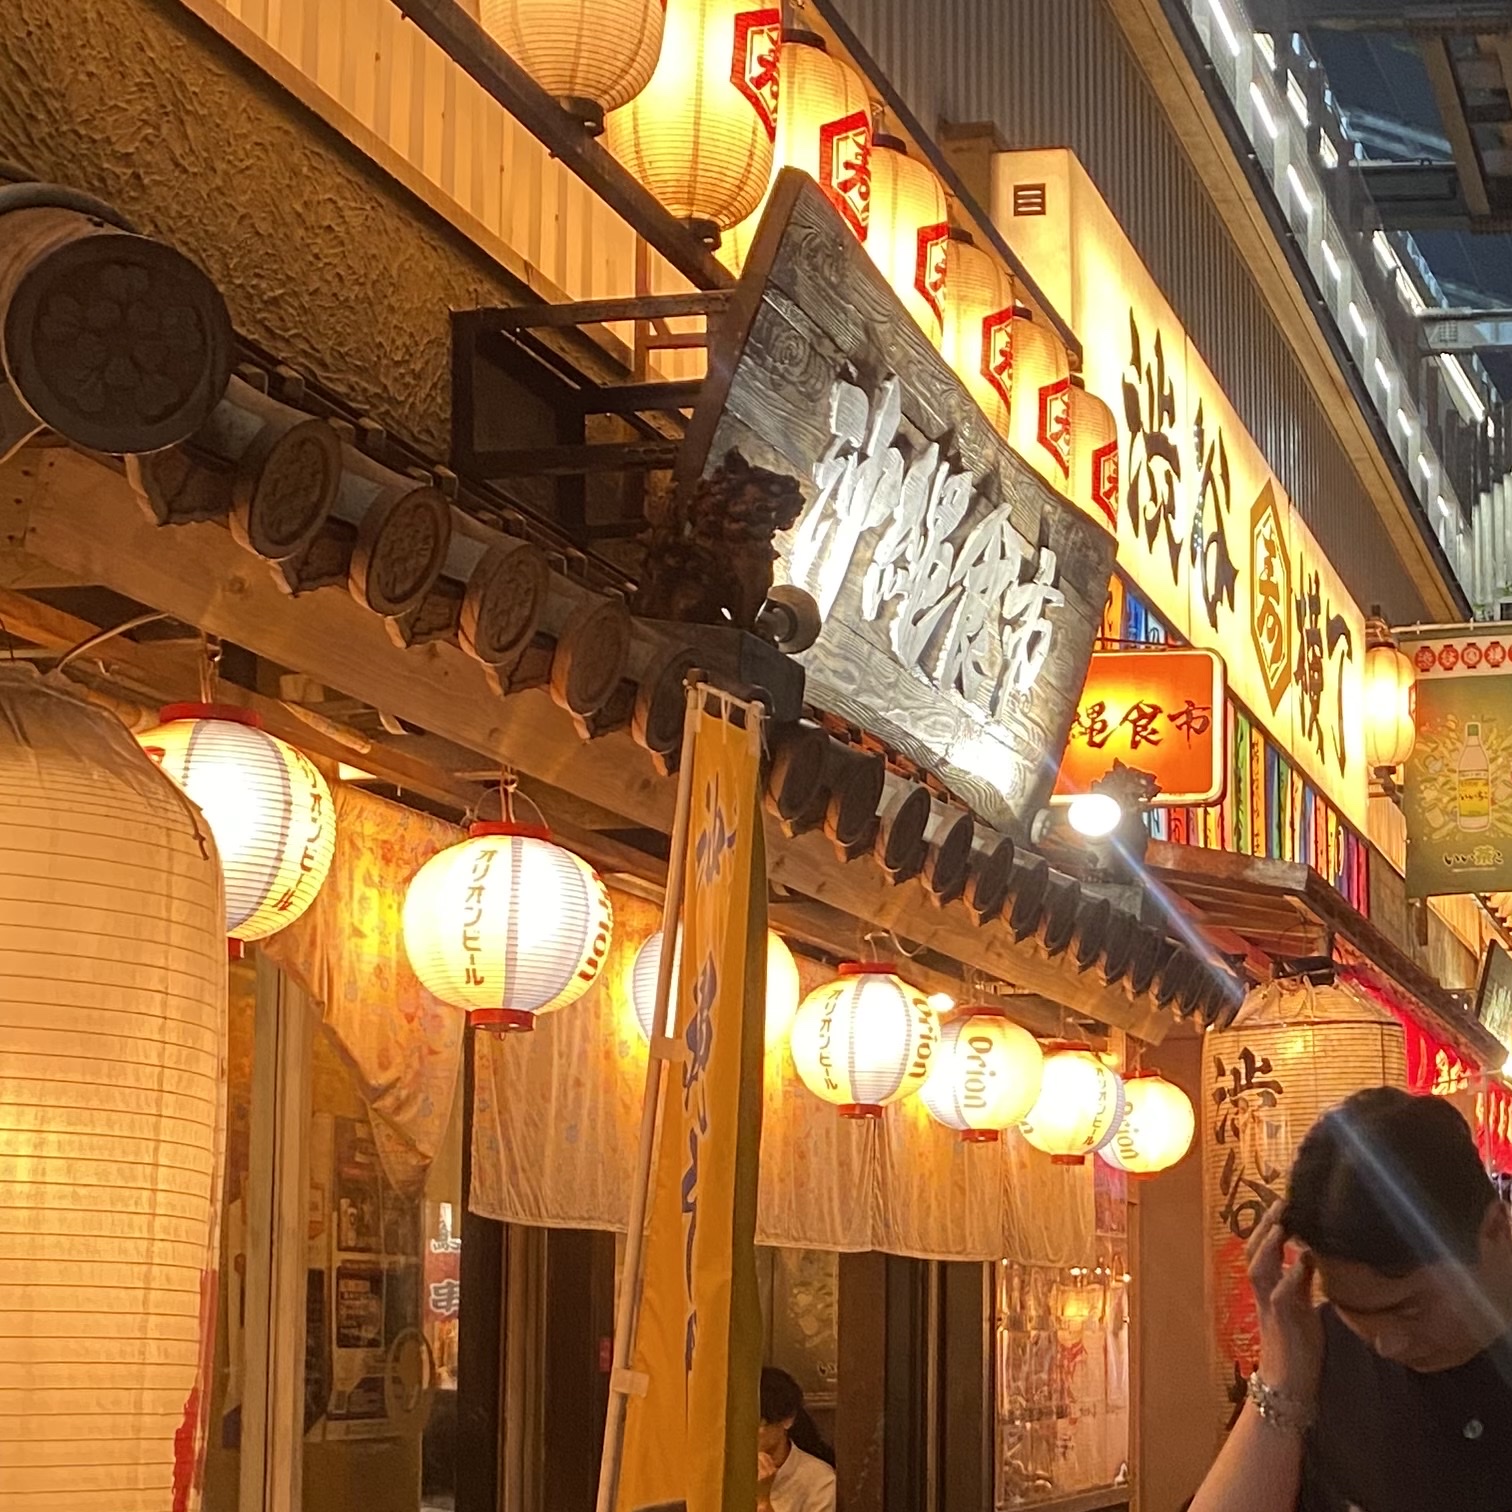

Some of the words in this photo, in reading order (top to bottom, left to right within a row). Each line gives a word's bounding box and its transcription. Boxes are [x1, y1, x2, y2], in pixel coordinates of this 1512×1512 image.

[462, 849, 498, 987] オリオンビール
[819, 988, 845, 1091] オリオンビール
[908, 997, 938, 1079] Orion
[963, 1035, 997, 1108] Orion
[1116, 1101, 1140, 1161] Orion
